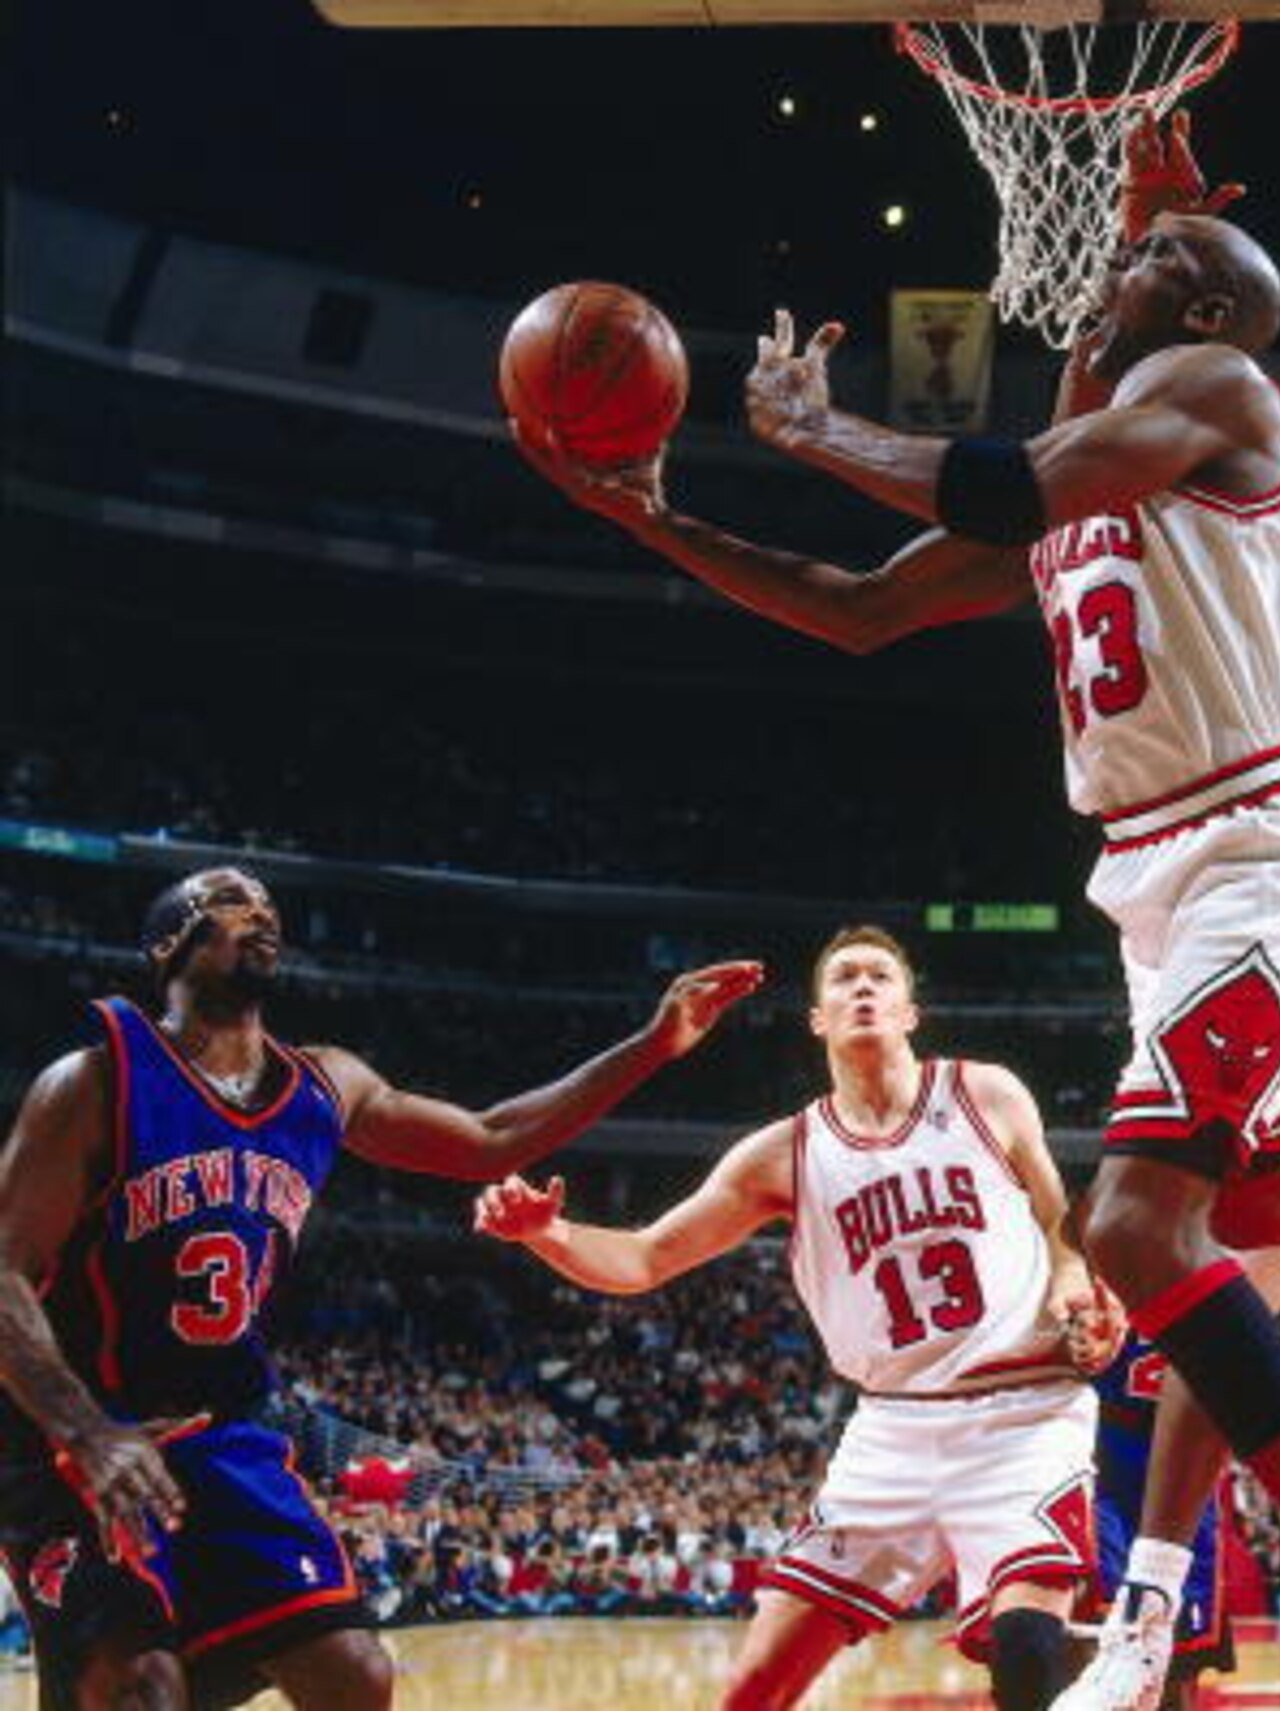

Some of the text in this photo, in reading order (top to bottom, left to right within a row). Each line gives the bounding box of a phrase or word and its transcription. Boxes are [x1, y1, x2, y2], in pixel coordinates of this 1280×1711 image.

[124, 1148, 234, 1242] NEW
[835, 1166, 987, 1276] BULLS
[875, 1238, 986, 1350] 13
